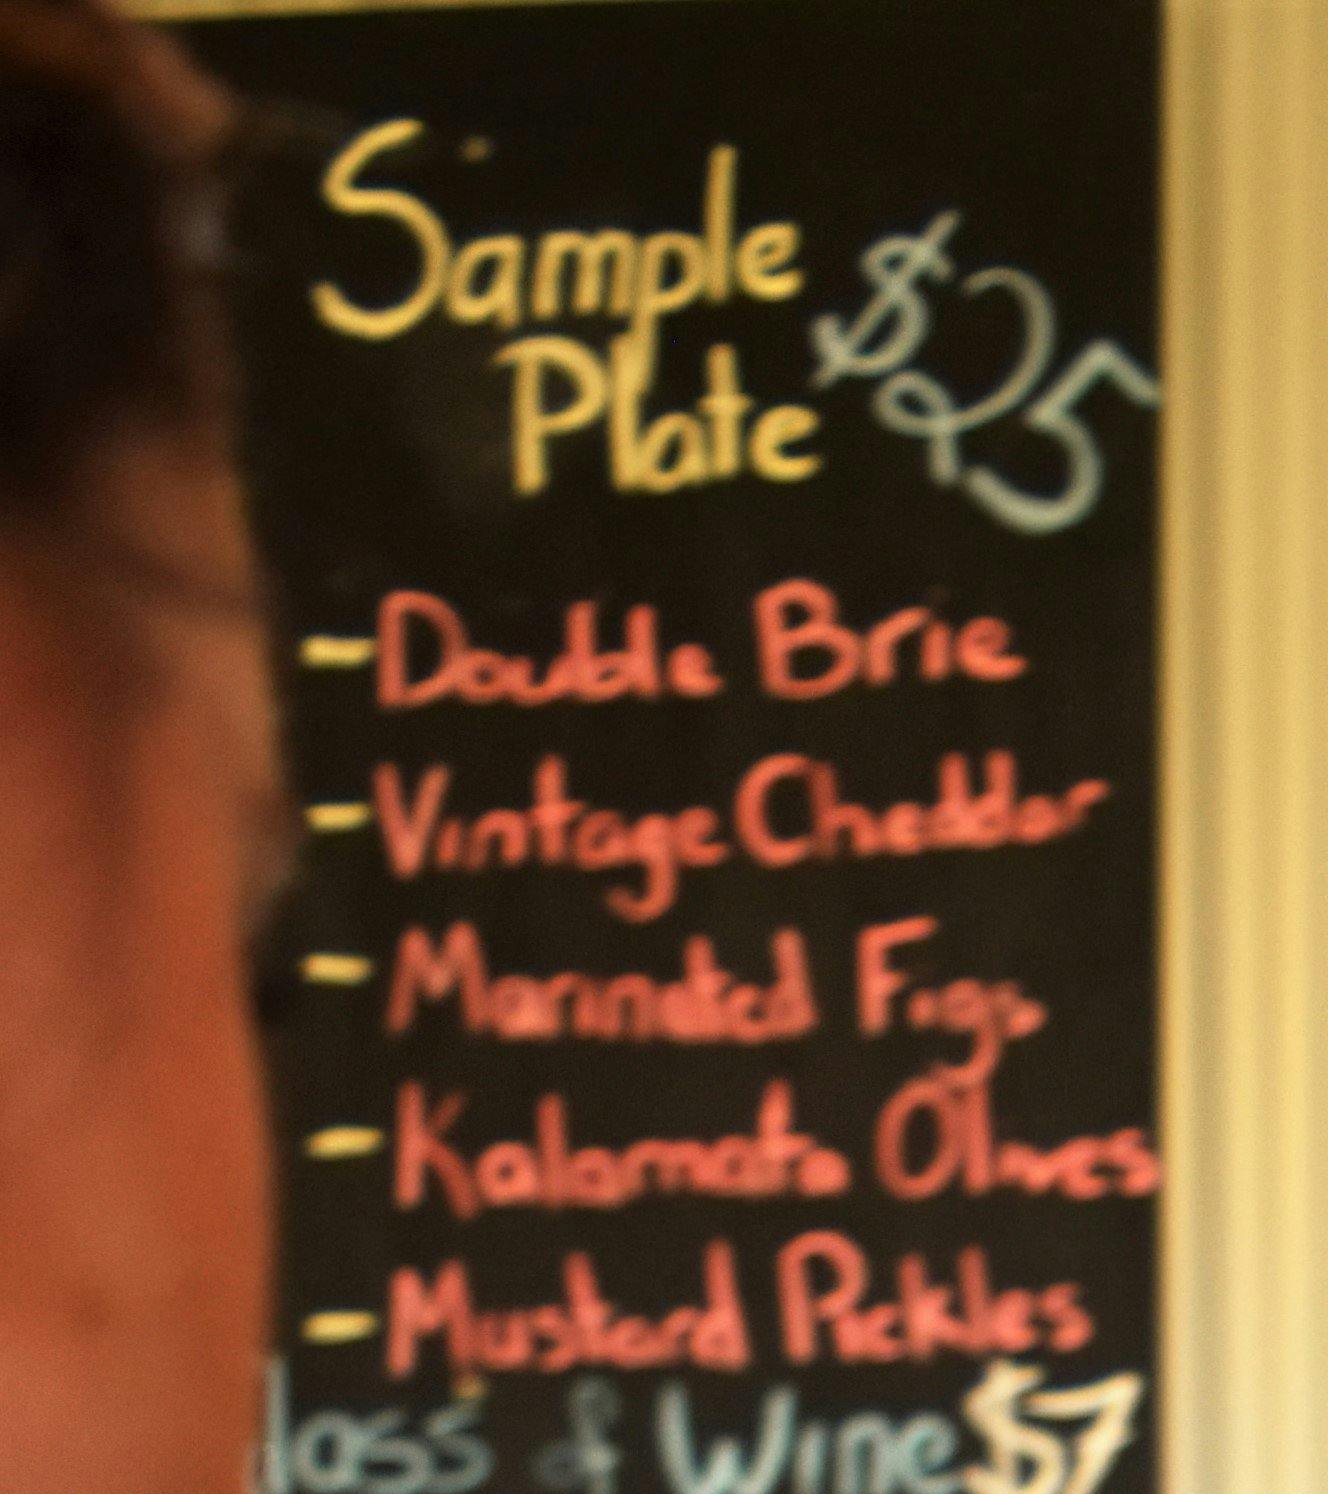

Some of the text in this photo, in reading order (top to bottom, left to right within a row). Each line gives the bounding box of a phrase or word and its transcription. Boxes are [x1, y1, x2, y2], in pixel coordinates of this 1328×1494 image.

[310, 118, 806, 392] Sample
[492, 331, 826, 496] Plate
[809, 209, 1161, 538] $25
[376, 577, 1028, 708] Double Brie
[372, 753, 730, 924] Vintage
[856, 914, 1048, 1085] Figs
[394, 1078, 853, 1219] Kalamata
[385, 1229, 1095, 1378] Mustard Pickles
